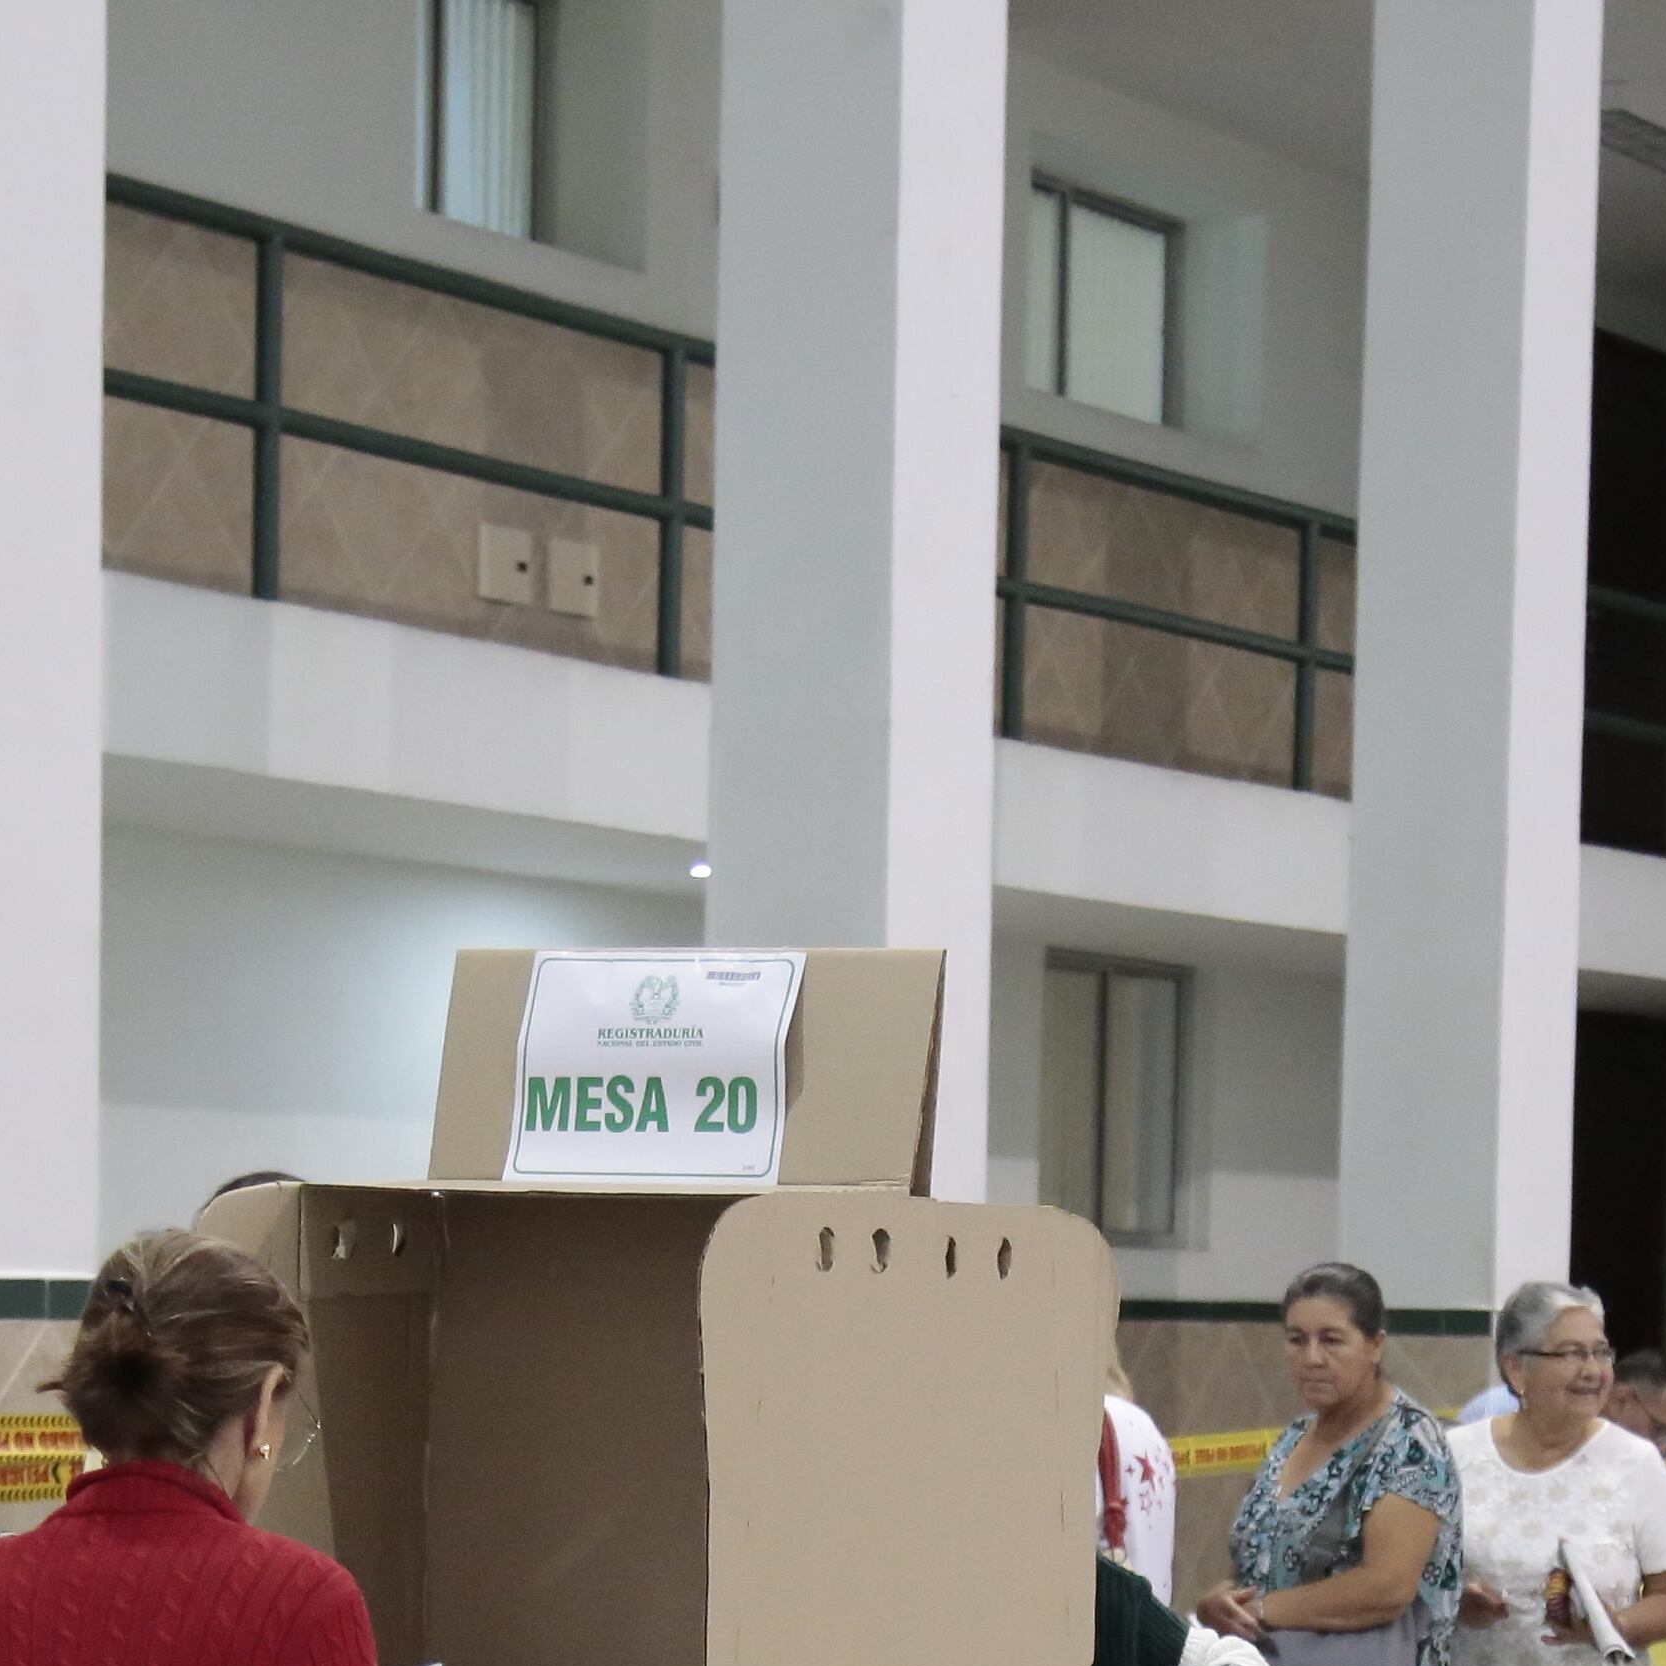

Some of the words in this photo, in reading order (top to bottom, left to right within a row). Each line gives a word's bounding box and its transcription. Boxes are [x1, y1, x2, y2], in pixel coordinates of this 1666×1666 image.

[597, 1025, 704, 1039] REGISTRADURÍA
[525, 1075, 669, 1133] MESA
[694, 1076, 758, 1134] 20
